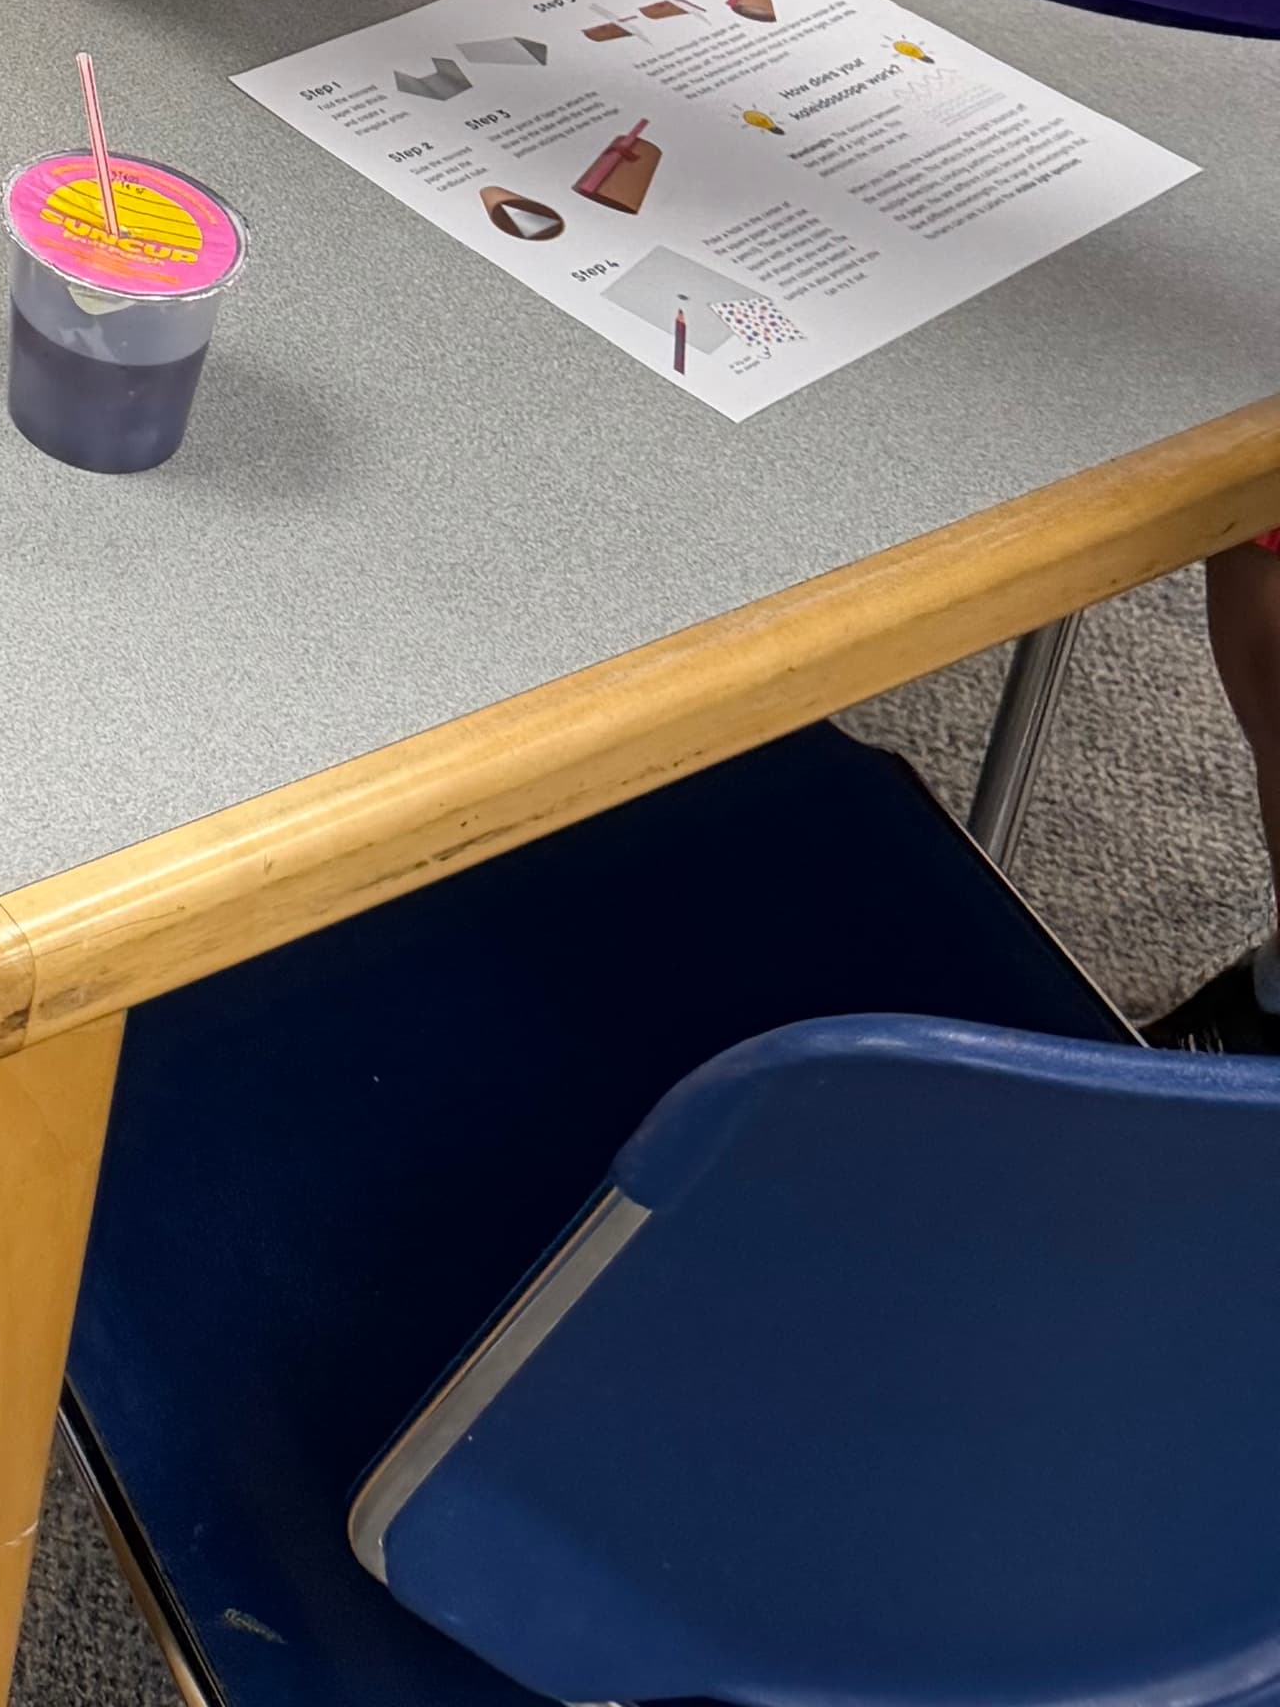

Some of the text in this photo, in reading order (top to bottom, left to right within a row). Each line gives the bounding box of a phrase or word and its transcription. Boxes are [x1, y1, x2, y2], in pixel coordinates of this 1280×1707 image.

[297, 82, 337, 101] Step
[778, 57, 868, 99] How does your
[788, 65, 906, 120] kaleidoscope work?
[462, 108, 513, 131] Step 3
[386, 140, 436, 164] Step 2
[40, 208, 199, 265] SUNCUP
[569, 257, 620, 284] Step 4
